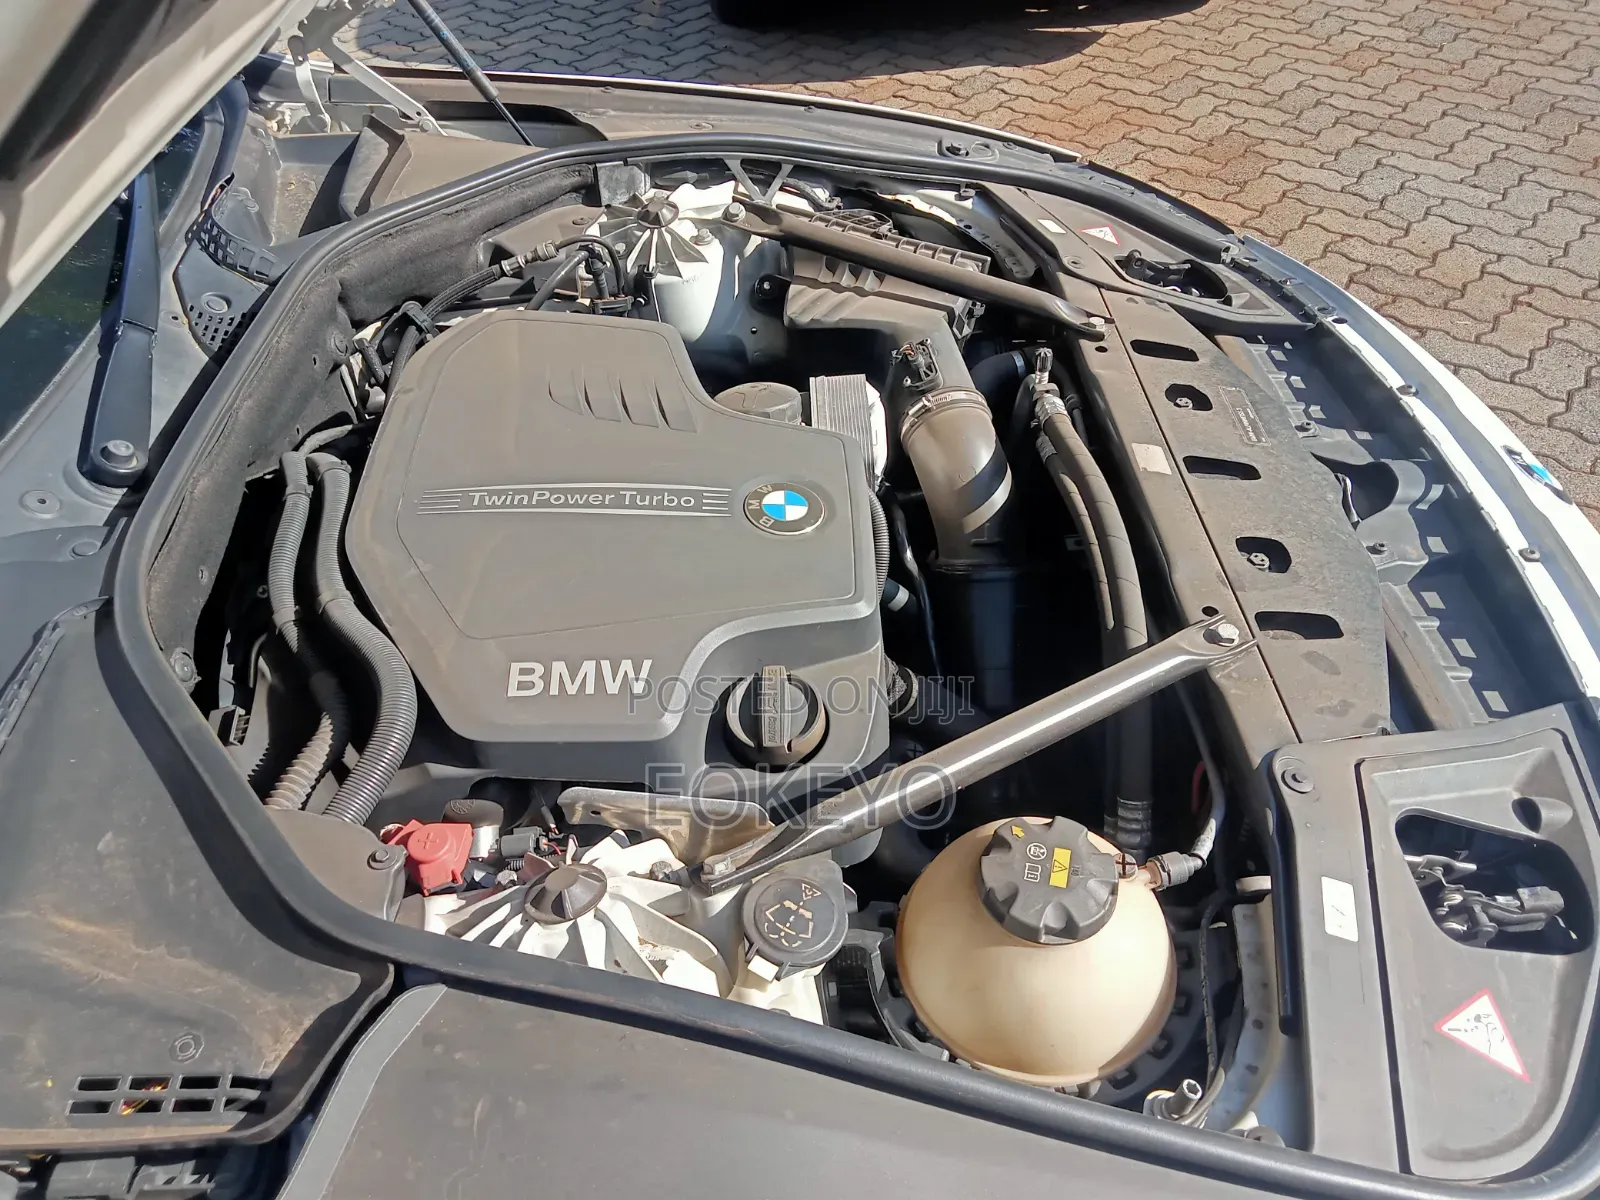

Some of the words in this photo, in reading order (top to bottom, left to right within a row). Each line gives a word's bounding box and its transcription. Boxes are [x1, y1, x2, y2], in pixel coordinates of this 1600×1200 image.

[468, 490, 615, 506] TwinPower
[619, 491, 696, 507] Turbo
[747, 484, 775, 528] BMW
[506, 659, 653, 698] BMW
